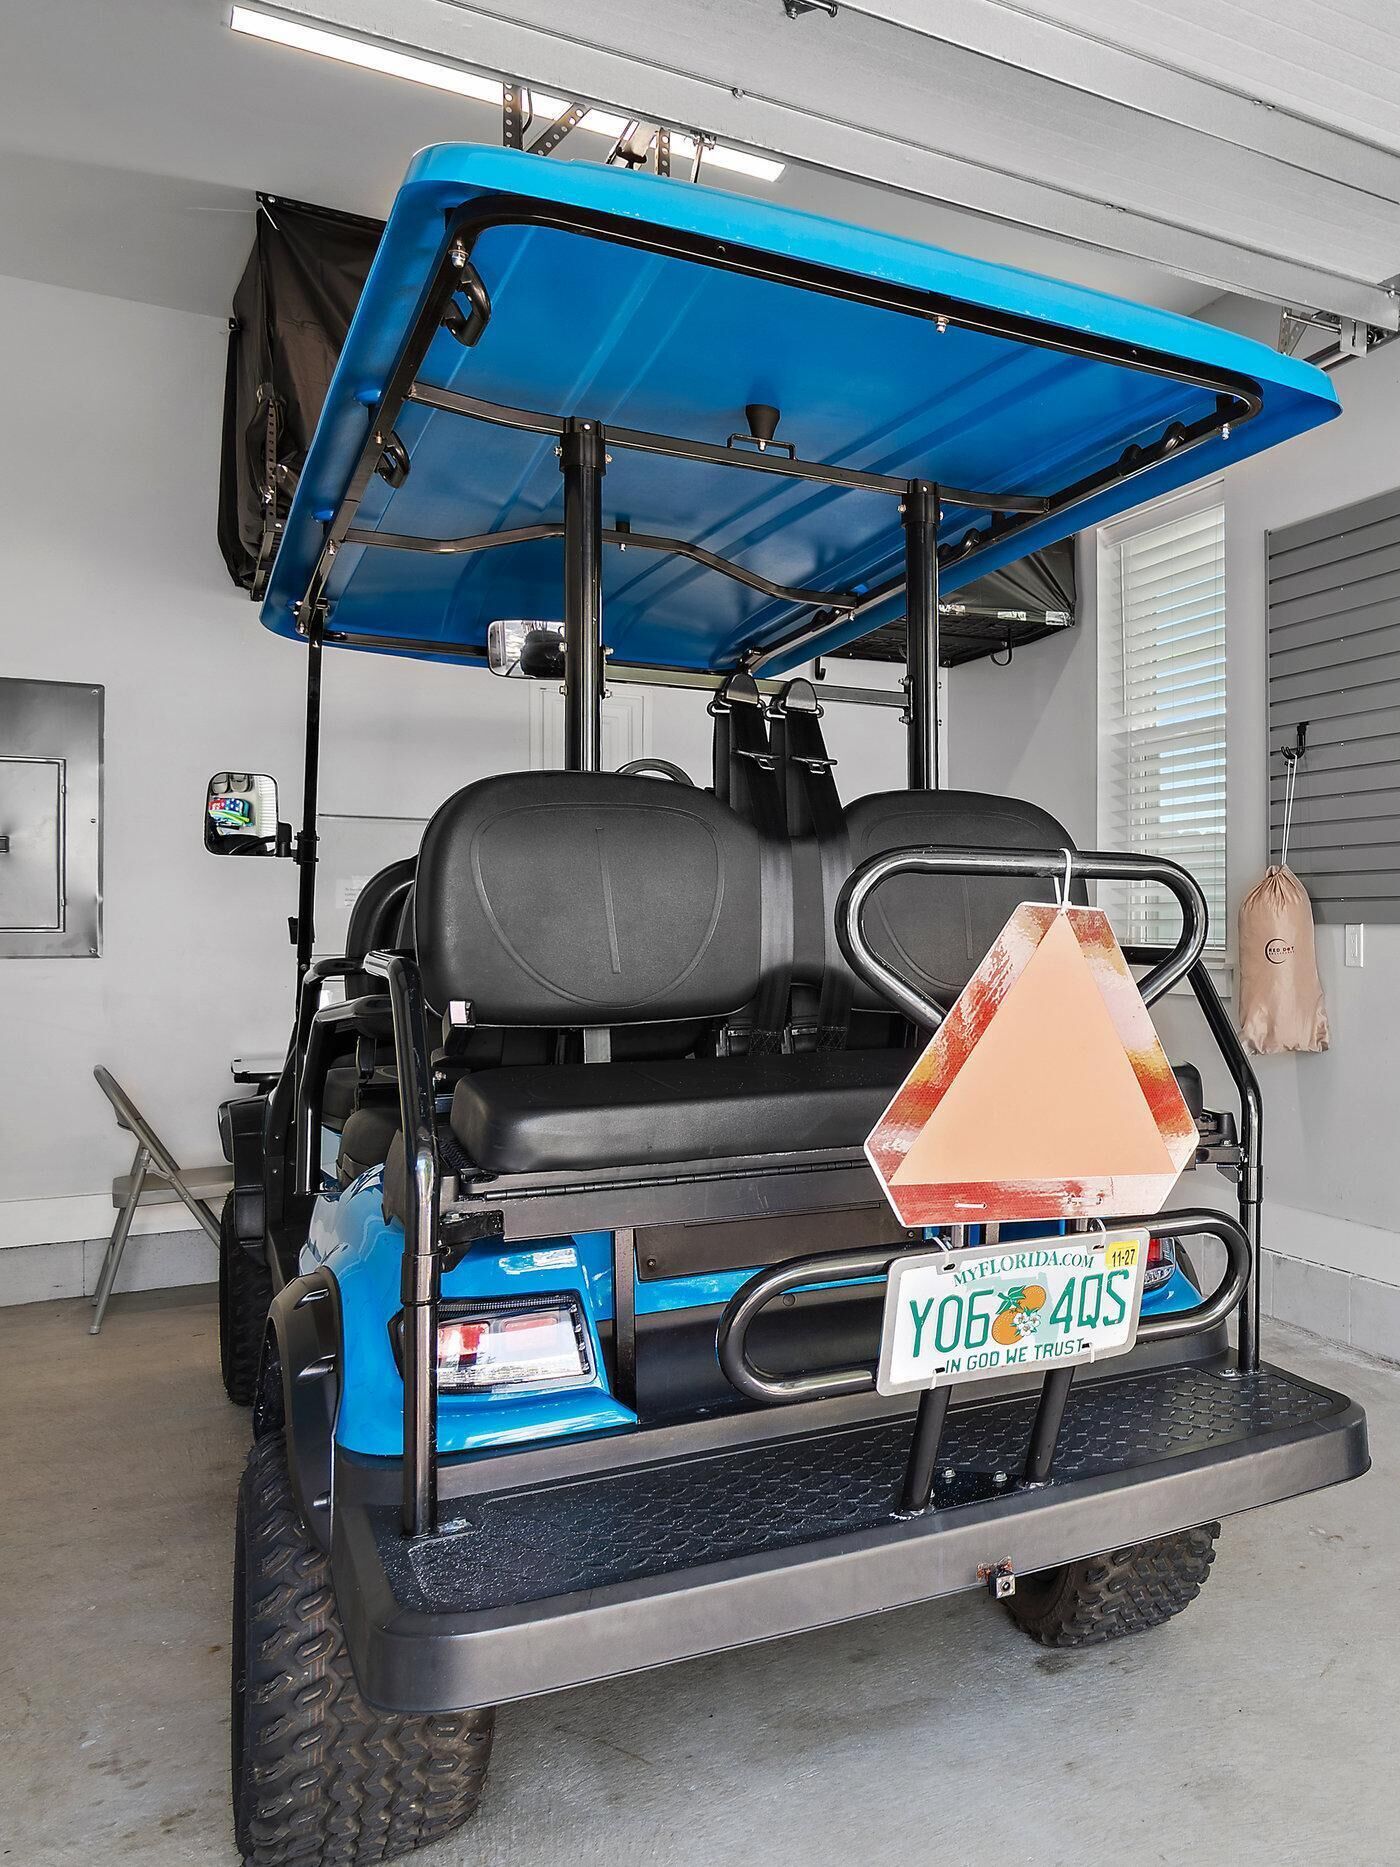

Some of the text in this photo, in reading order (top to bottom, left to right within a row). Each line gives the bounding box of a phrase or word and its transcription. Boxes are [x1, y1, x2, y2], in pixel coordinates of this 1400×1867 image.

[953, 1250, 1094, 1288] MYFLORIDA.COM
[1049, 1268, 1130, 1334] 4QS
[944, 1338, 1084, 1375] IN GOD WE TRUST
